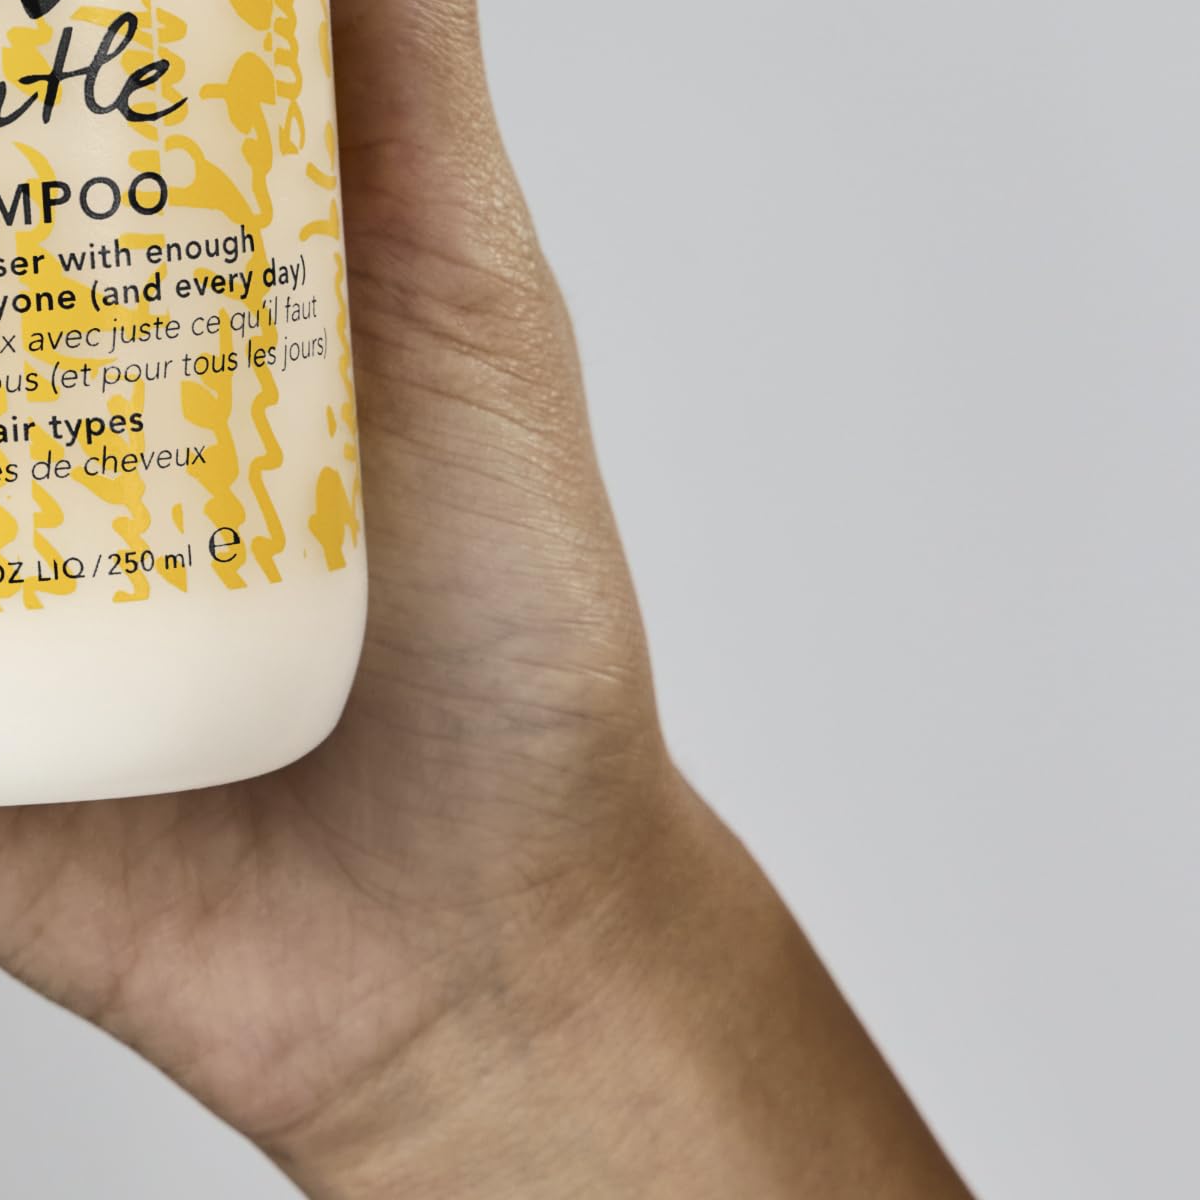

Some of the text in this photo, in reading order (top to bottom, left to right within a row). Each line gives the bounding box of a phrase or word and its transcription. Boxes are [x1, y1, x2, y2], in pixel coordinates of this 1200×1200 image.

[58, 239, 131, 271] with
[146, 225, 254, 264] enough
[91, 272, 161, 312] (and
[176, 271, 253, 300] every
[263, 255, 305, 290] day)
[29, 328, 100, 351] avec
[109, 317, 180, 353] juste
[192, 316, 220, 336] ce
[285, 297, 316, 322] faut
[52, 362, 91, 394] (et
[103, 360, 172, 393] pour
[183, 352, 238, 376] tous
[248, 340, 276, 367] les
[282, 328, 327, 371] jours)
[49, 413, 143, 447] types
[32, 450, 71, 480] de
[84, 446, 205, 476] cheveux
[165, 545, 191, 569] ml
